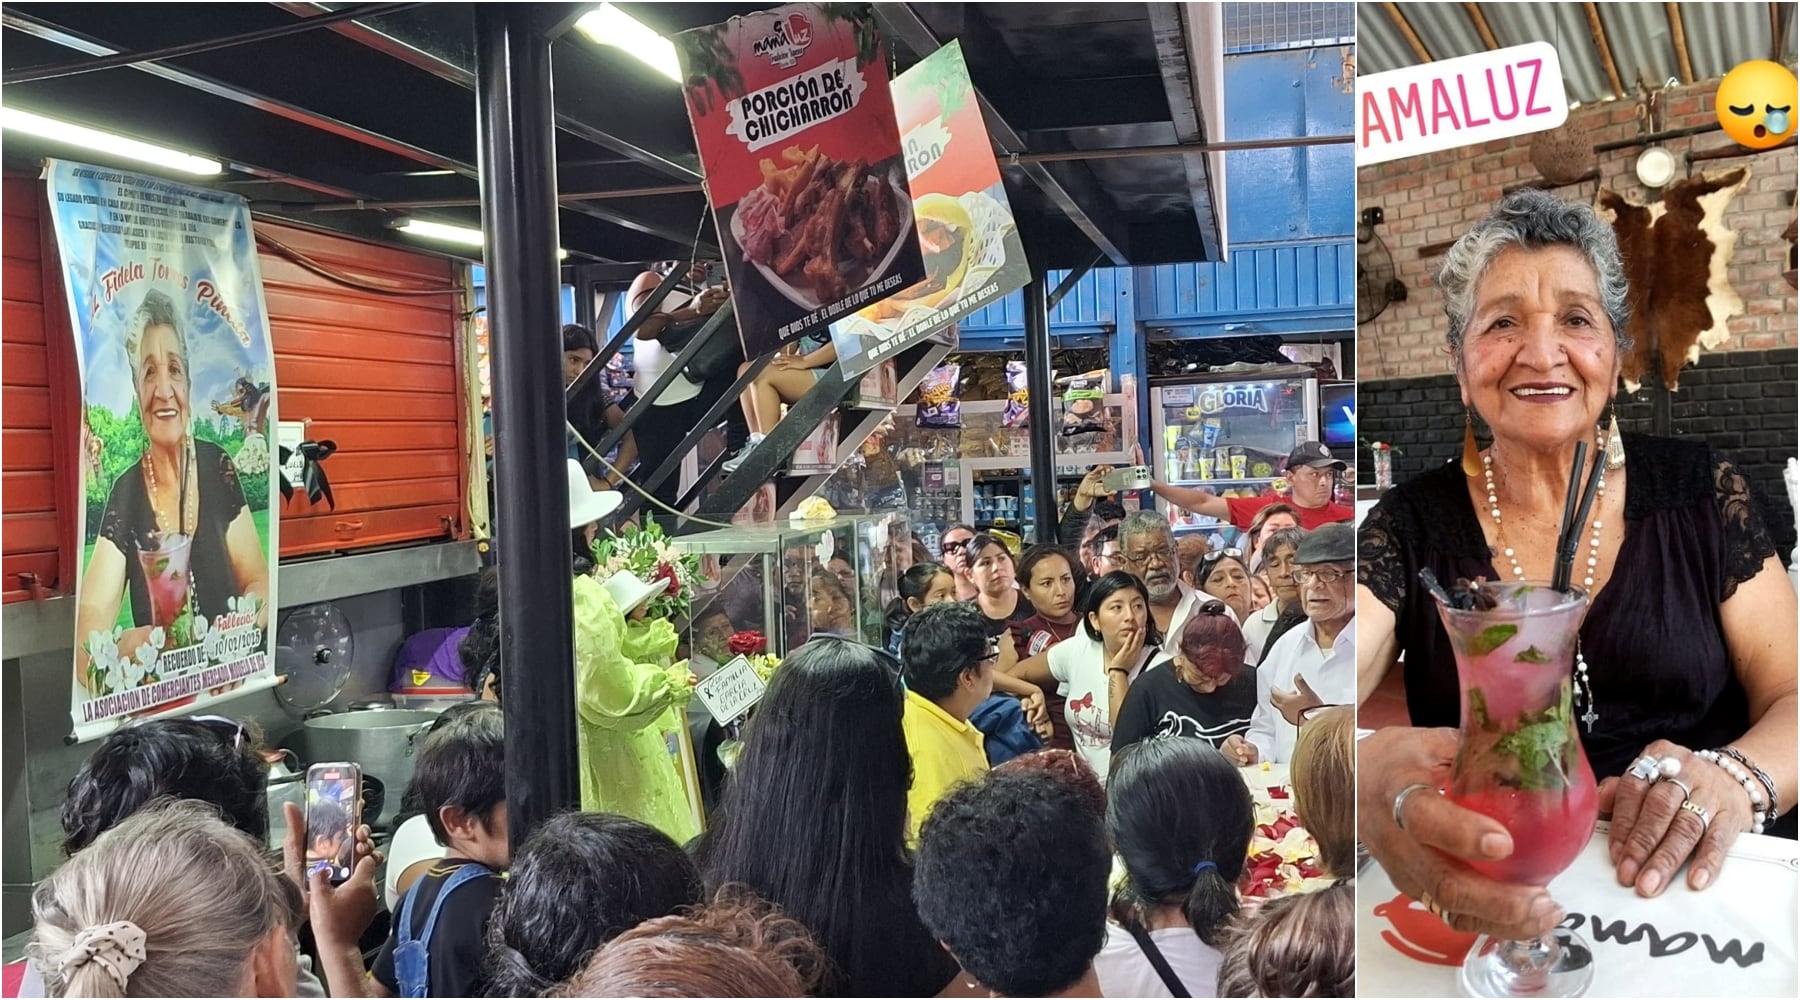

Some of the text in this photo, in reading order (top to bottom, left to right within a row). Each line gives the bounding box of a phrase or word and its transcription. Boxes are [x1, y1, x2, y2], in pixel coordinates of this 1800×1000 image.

[741, 69, 844, 120] PORCIÓN DE
[101, 261, 145, 302] Fidela
[150, 257, 190, 289] Tors
[778, 327, 791, 340] QUE
[790, 319, 804, 334] DIOS
[803, 316, 811, 328] TE
[821, 308, 829, 319] EL
[828, 300, 845, 316] DOBLE
[845, 296, 852, 311] DE
[852, 293, 859, 304] LO
[859, 289, 870, 303] QUE
[870, 286, 877, 297] TU
[876, 283, 885, 294] ME
[884, 272, 903, 290] DESEAS
[867, 347, 879, 360] QUE
[879, 339, 892, 354] DIOS
[891, 336, 899, 348] TE
[908, 327, 917, 338] EL
[915, 317, 933, 334] DOBLE
[932, 313, 941, 326] DE
[940, 309, 949, 321] LO
[949, 303, 961, 317] QUE
[960, 298, 969, 309] TU
[968, 294, 978, 306] ME
[977, 281, 999, 300] DESEAS
[1199, 387, 1269, 414] GLORIA
[163, 645, 205, 673] RECUERDO DE
[215, 630, 260, 657] 10/02/2025
[82, 703, 94, 722] LA
[94, 690, 140, 720] ASOCIACION
[141, 686, 151, 707] DE
[151, 673, 201, 704] COMERCIANTES
[201, 664, 230, 689] MERCADO
[715, 665, 747, 693] FAMILIA
